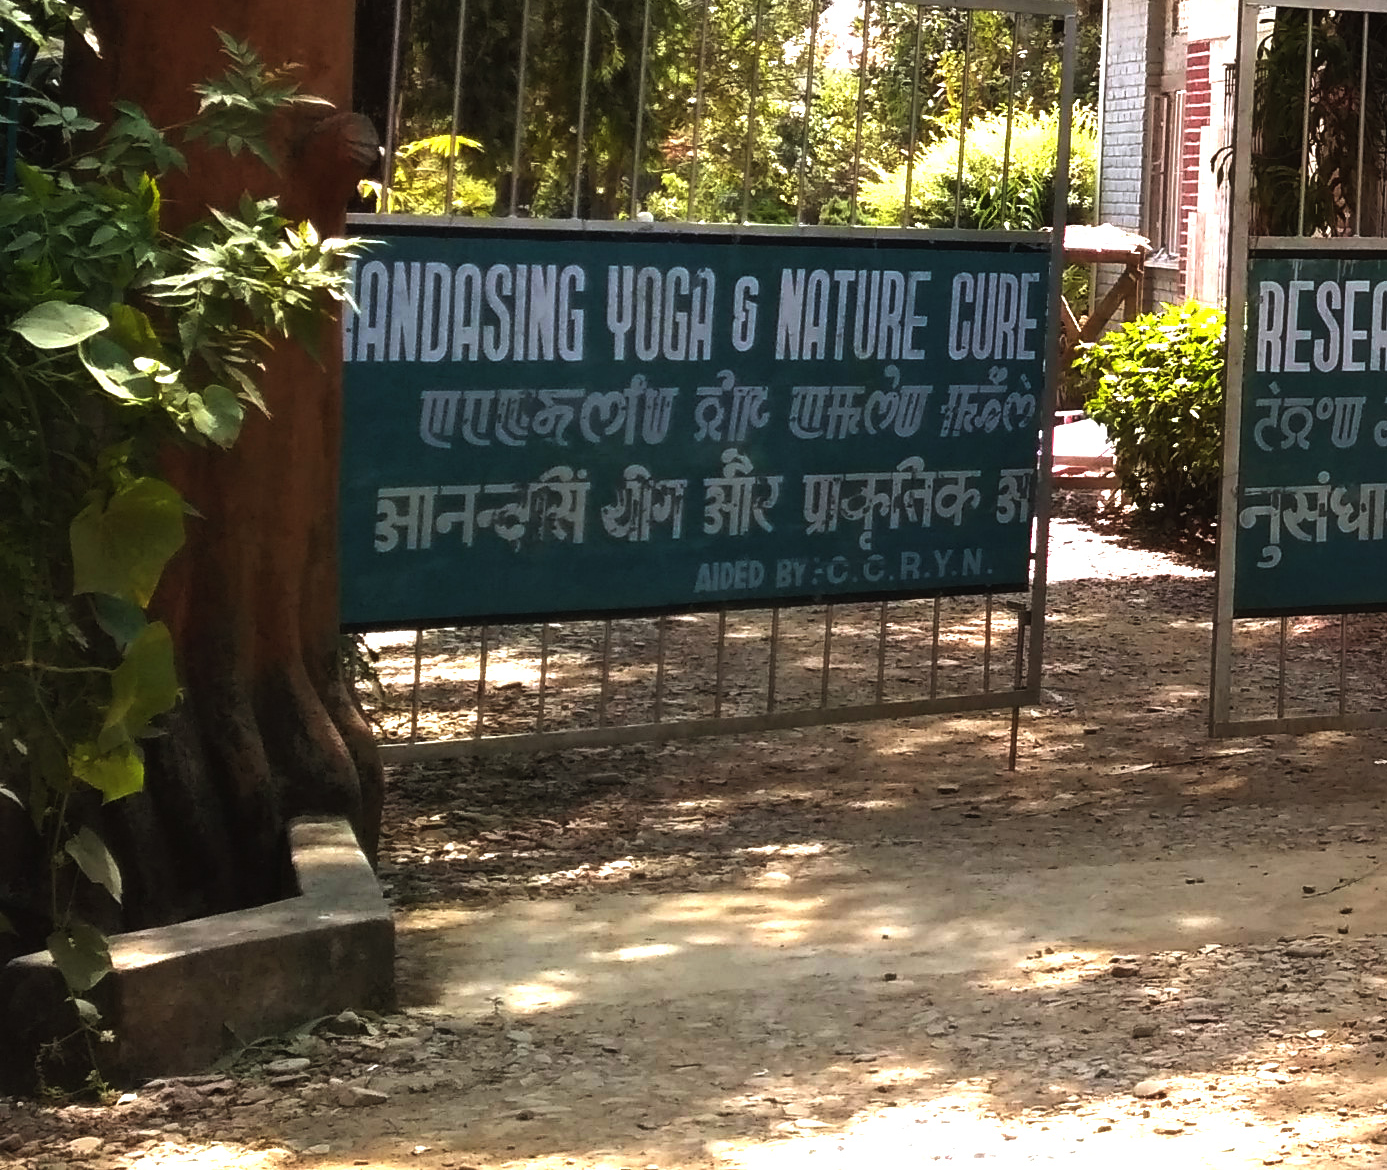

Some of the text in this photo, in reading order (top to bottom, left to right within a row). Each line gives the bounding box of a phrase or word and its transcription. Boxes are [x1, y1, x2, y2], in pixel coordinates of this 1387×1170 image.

[607, 265, 714, 361] YOGA
[732, 276, 759, 352] &
[775, 268, 931, 361] NATURE
[948, 272, 1040, 360] CURE
[704, 448, 784, 535] और
[803, 456, 981, 550] प्राकृतिक
[695, 561, 764, 592] AIDED
